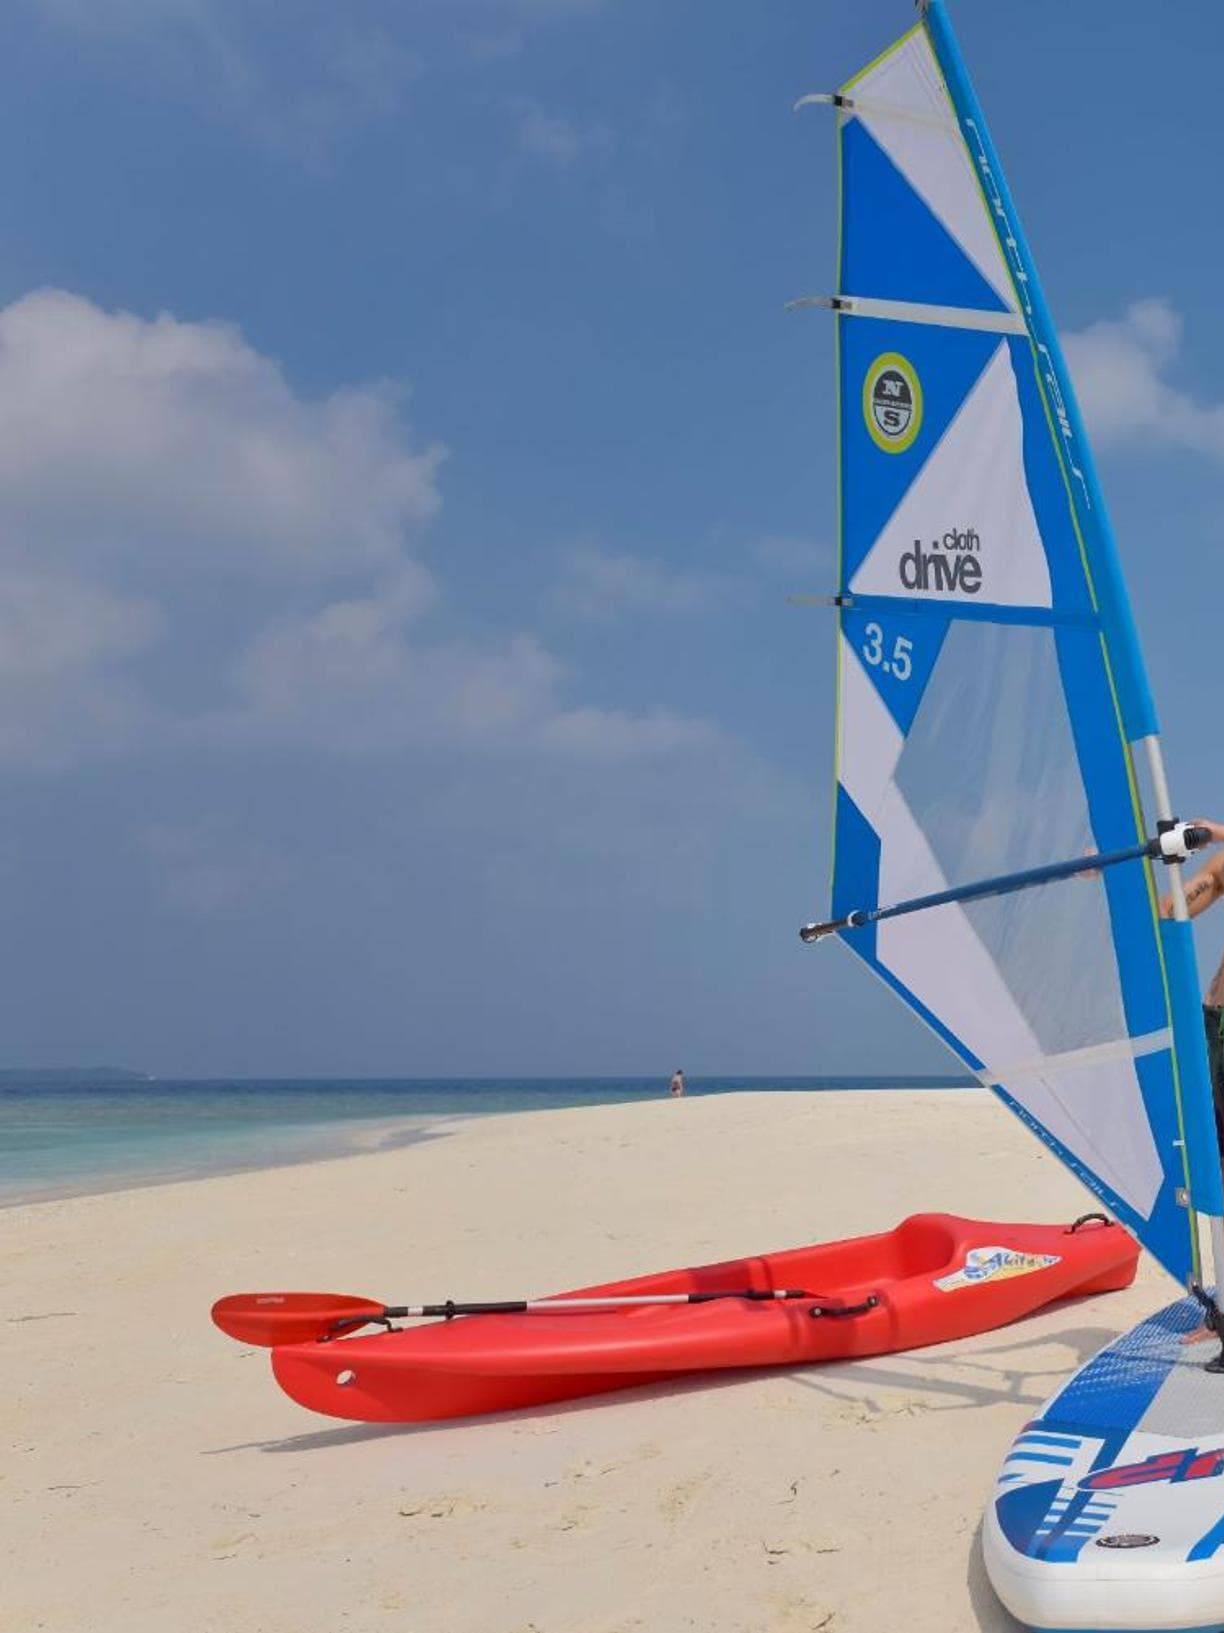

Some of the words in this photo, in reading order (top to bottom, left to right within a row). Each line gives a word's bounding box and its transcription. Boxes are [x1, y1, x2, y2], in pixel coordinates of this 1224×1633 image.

[882, 379, 904, 397] N
[884, 410, 900, 427] S
[943, 527, 980, 551] cloth
[899, 539, 982, 594] drive
[863, 622, 913, 681] 3.5
